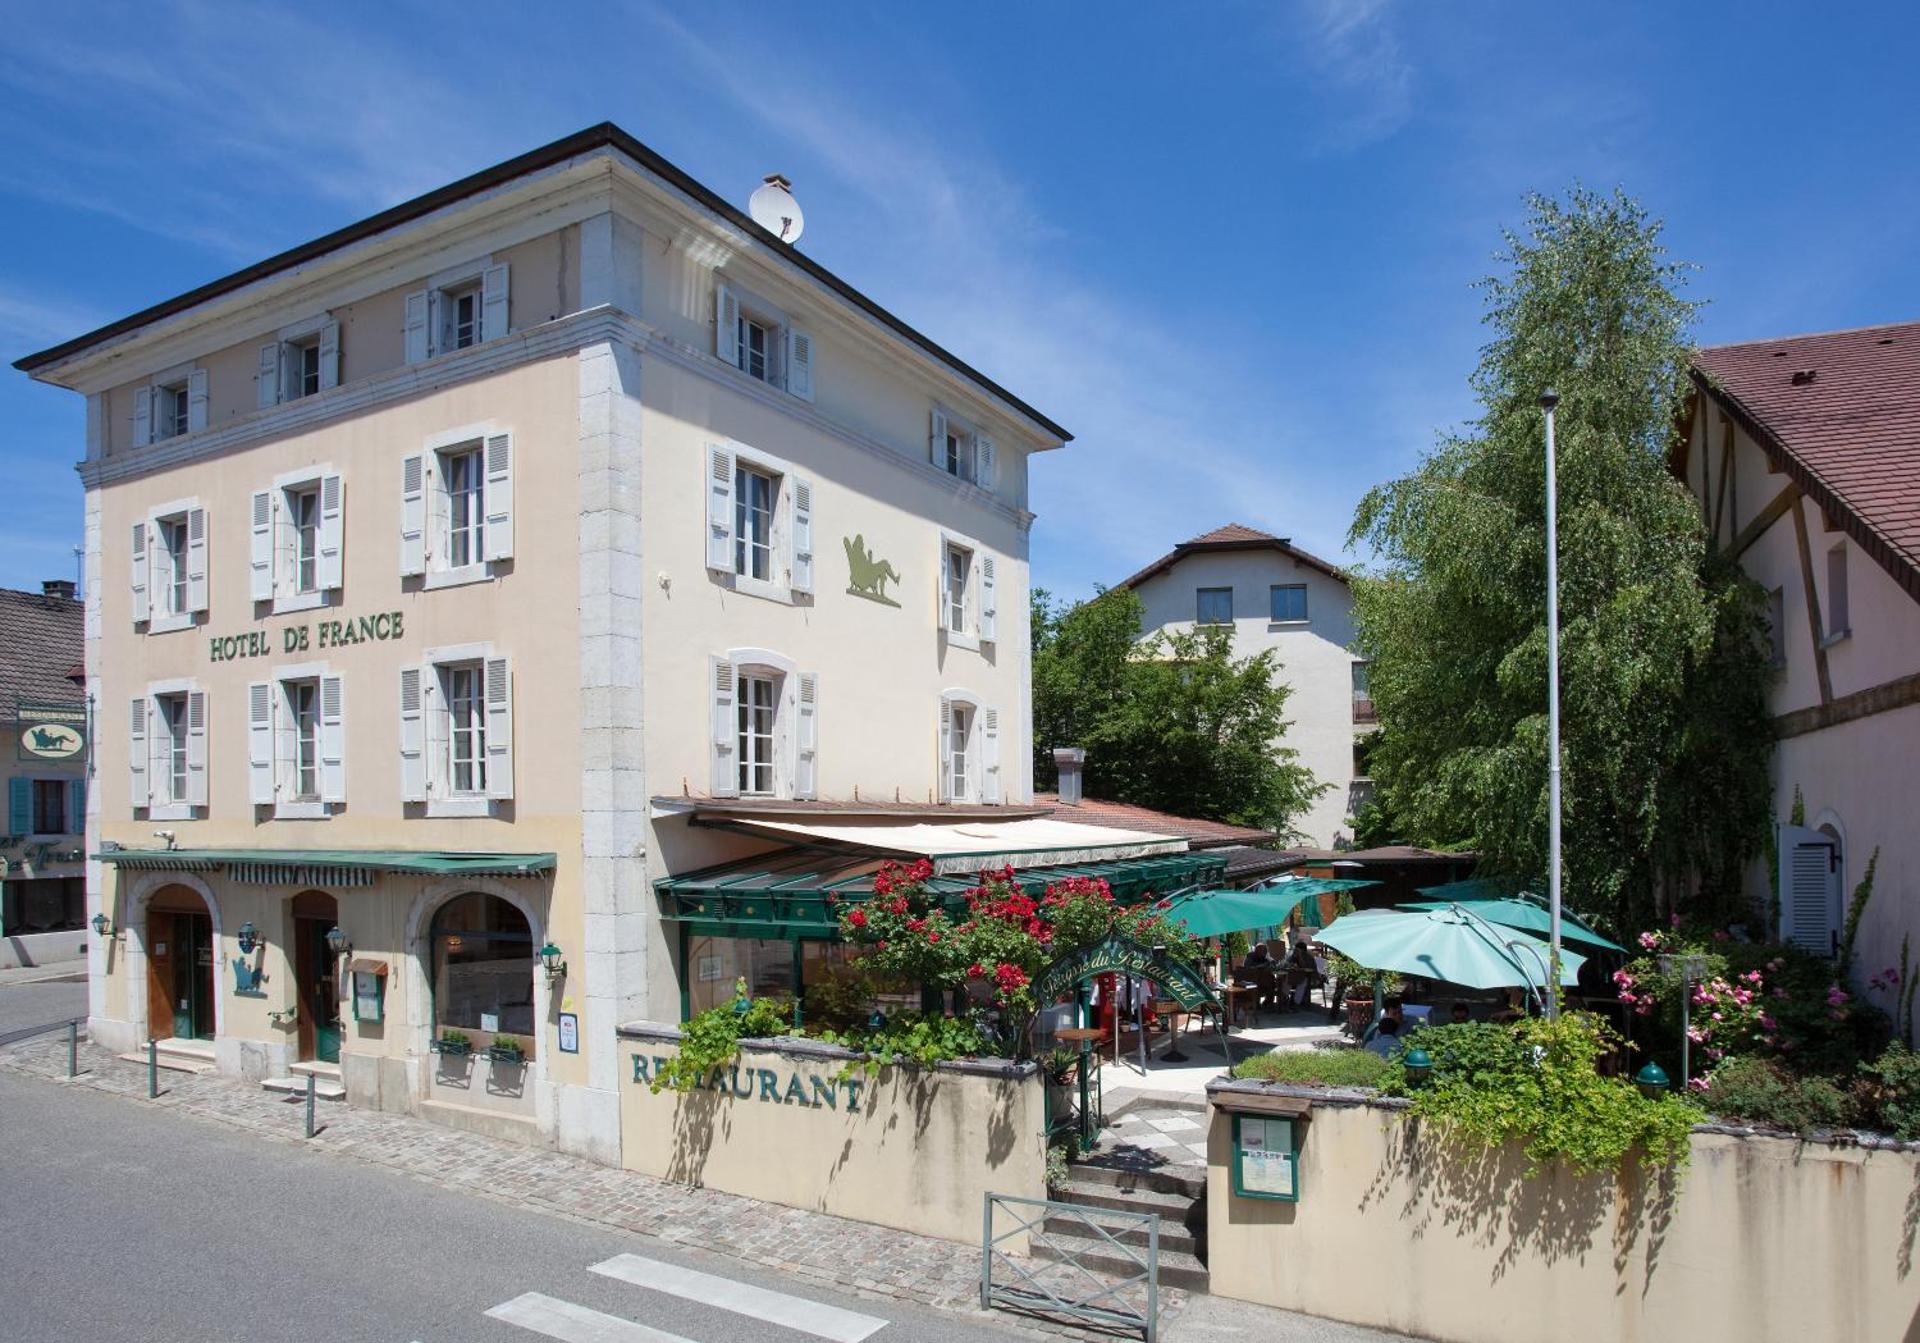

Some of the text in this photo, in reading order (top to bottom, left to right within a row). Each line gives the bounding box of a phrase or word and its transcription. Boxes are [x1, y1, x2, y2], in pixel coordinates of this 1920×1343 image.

[210, 611, 404, 662] HOTEL DE FRANCE
[1091, 950, 1110, 969] du
[1111, 950, 1197, 1001] Restaurant
